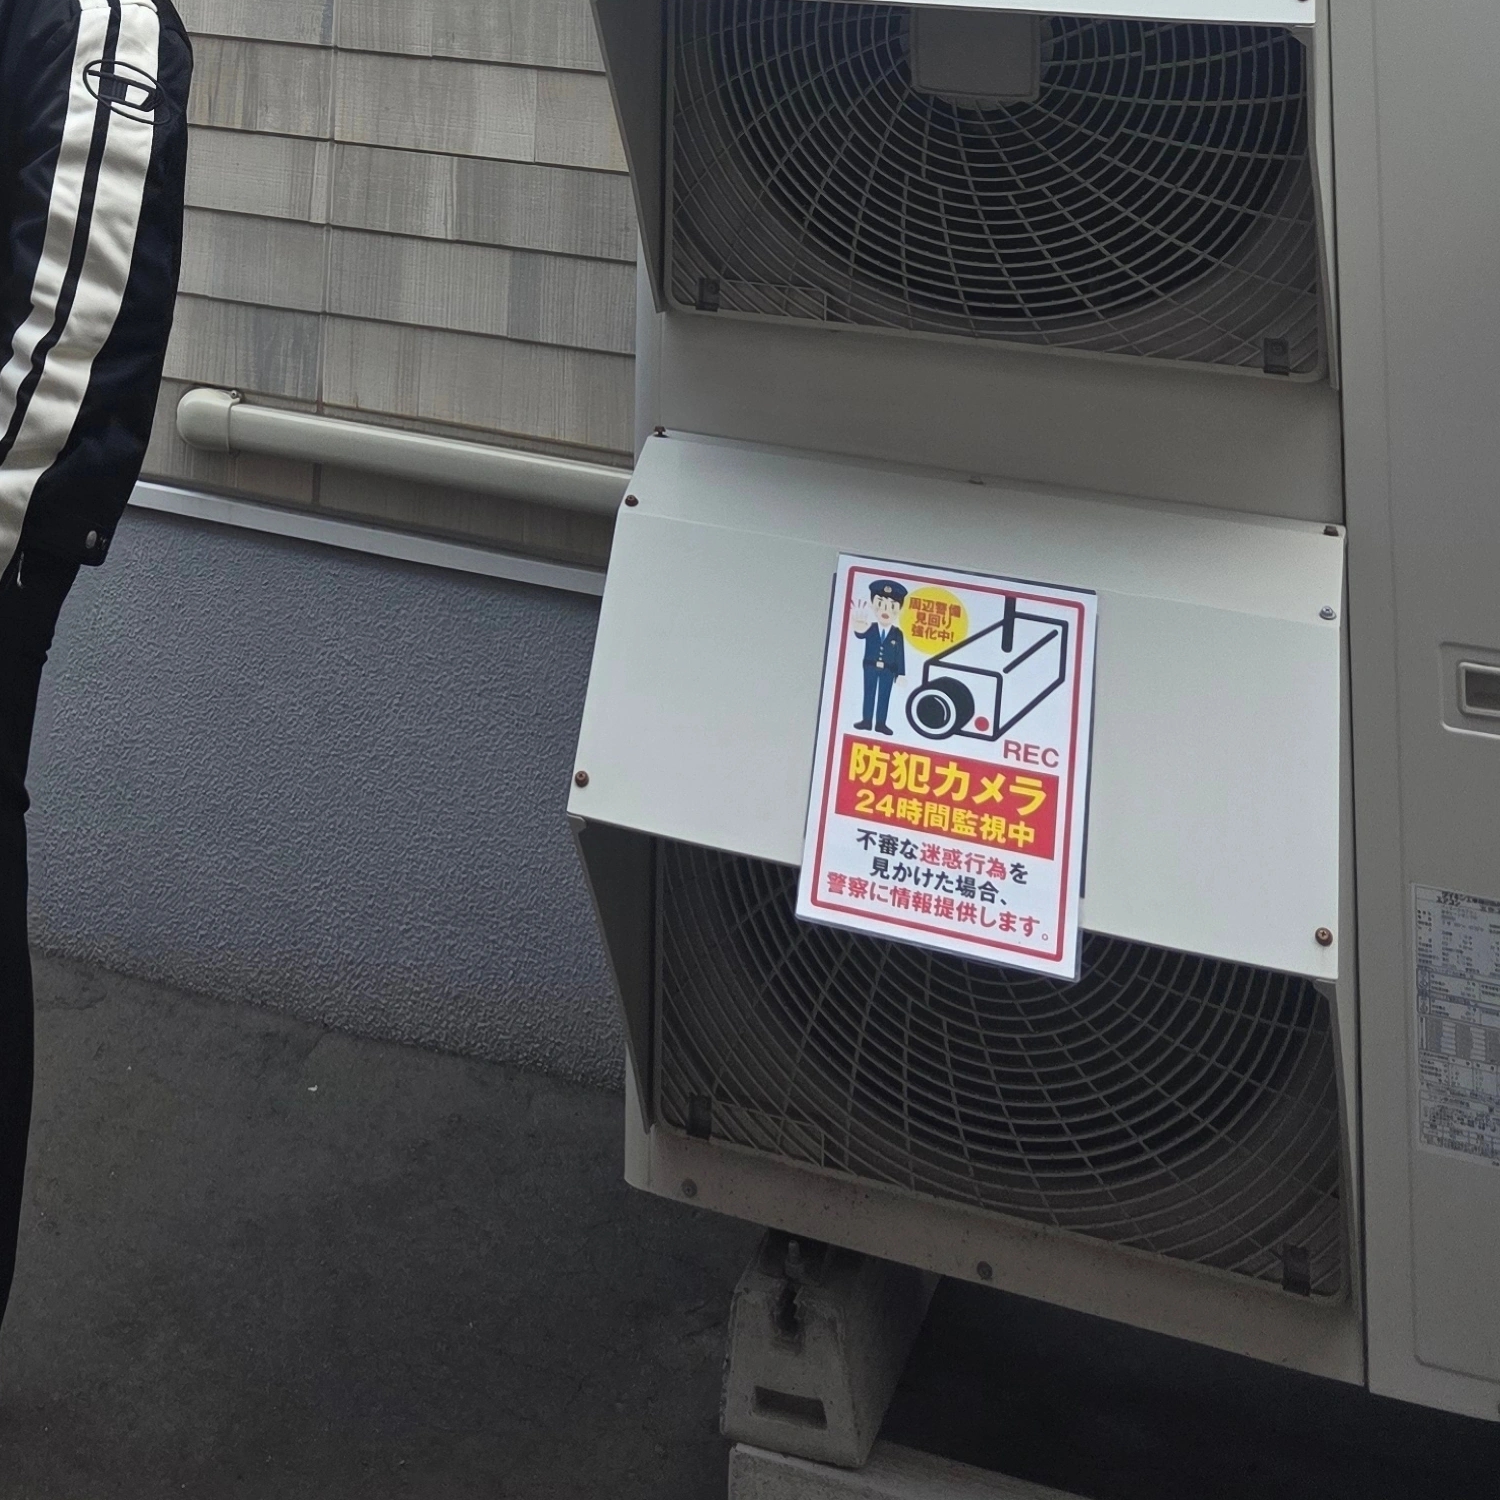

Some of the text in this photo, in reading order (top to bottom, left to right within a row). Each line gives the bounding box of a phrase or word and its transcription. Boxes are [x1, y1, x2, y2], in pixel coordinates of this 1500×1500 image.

[848, 741, 1048, 817] 防犯カメラ
[1002, 739, 1060, 769] REC
[854, 788, 1036, 849] 24時間監視中
[855, 827, 1030, 886] 不審な迷惑行為を
[869, 856, 1008, 906] 見かけた場合、
[826, 871, 1050, 942] 警察に情報提供します。
